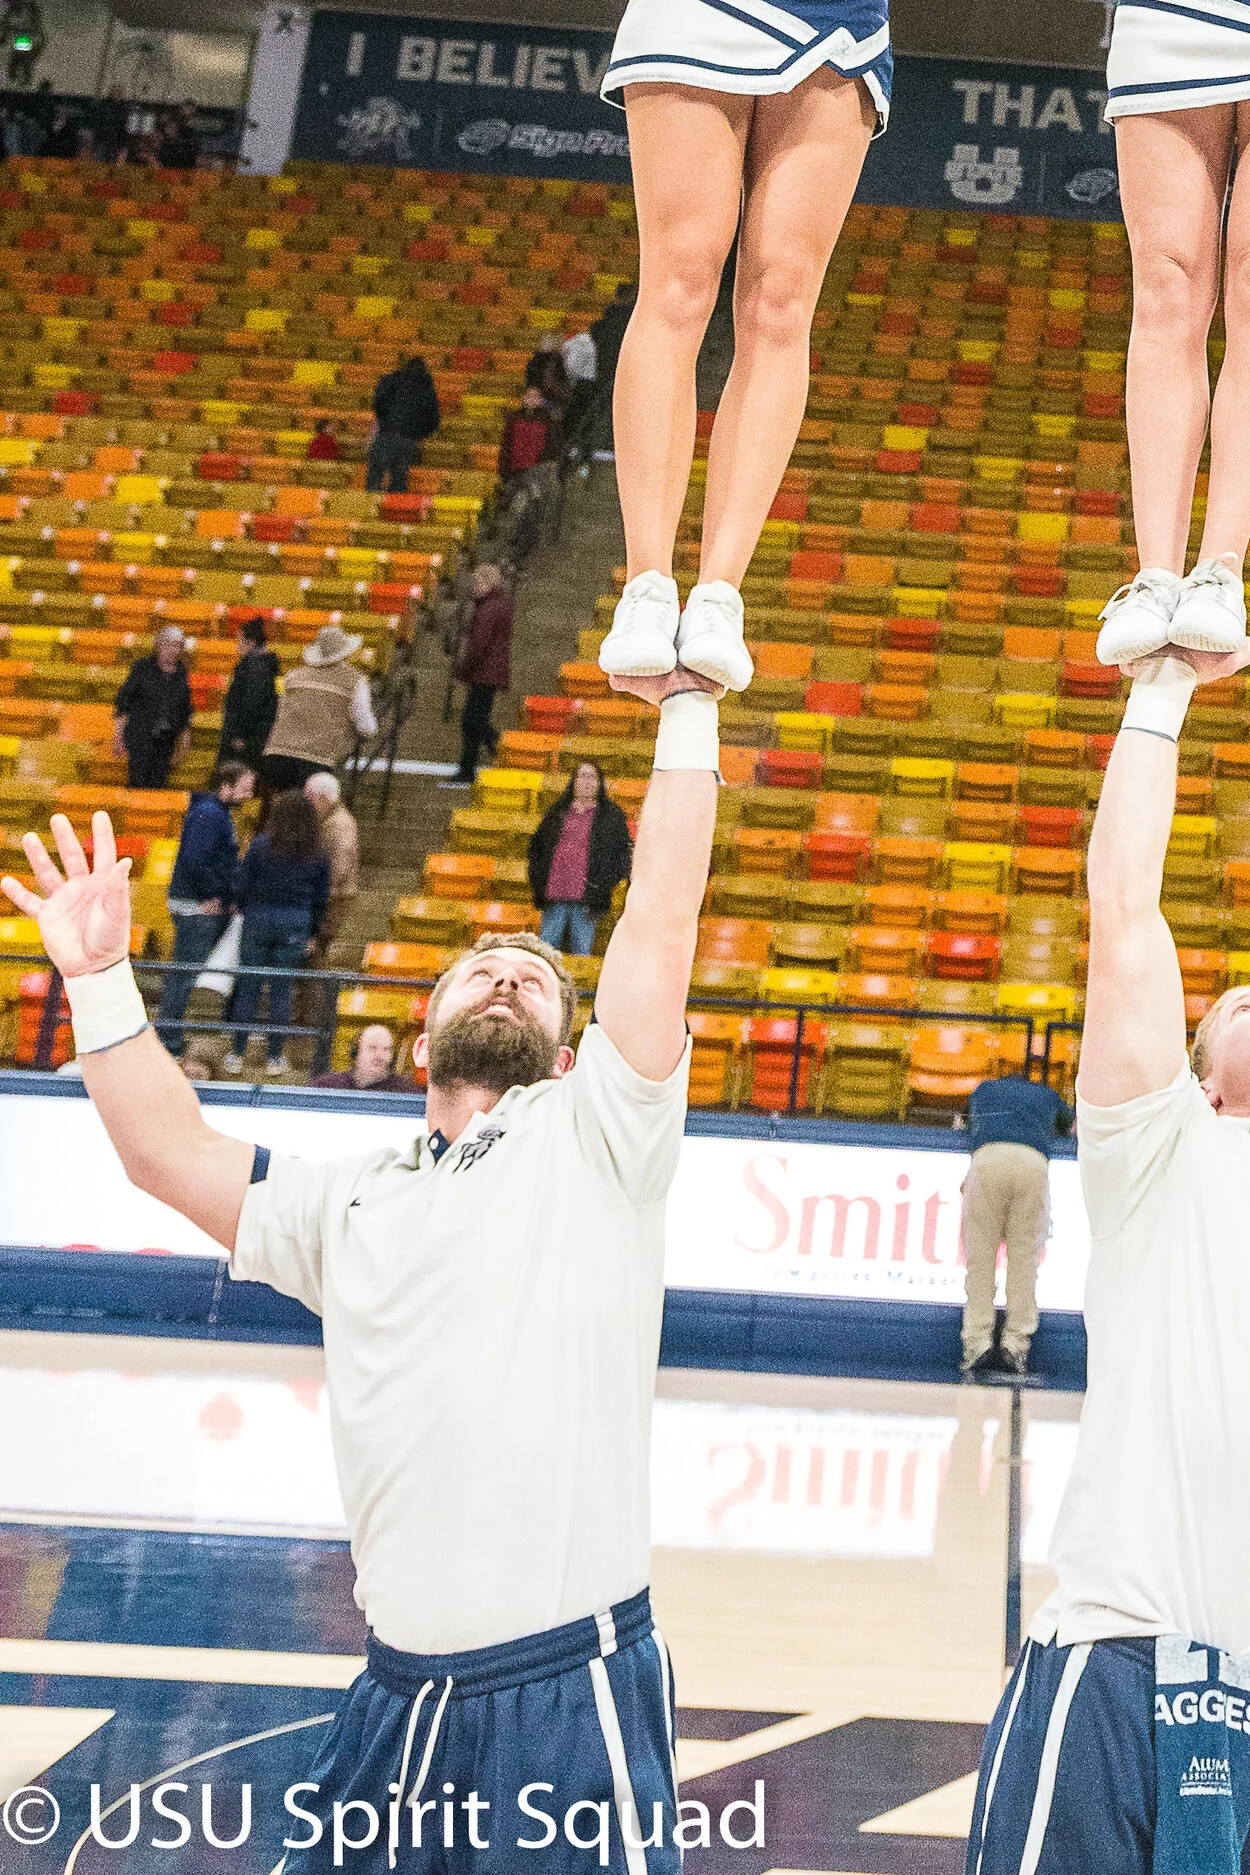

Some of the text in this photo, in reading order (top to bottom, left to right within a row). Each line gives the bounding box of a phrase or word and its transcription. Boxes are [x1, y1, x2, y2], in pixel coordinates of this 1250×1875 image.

[346, 31, 610, 95] I BELIEV
[733, 1153, 968, 1267] Smit
[1188, 1756, 1229, 1773] ALUM
